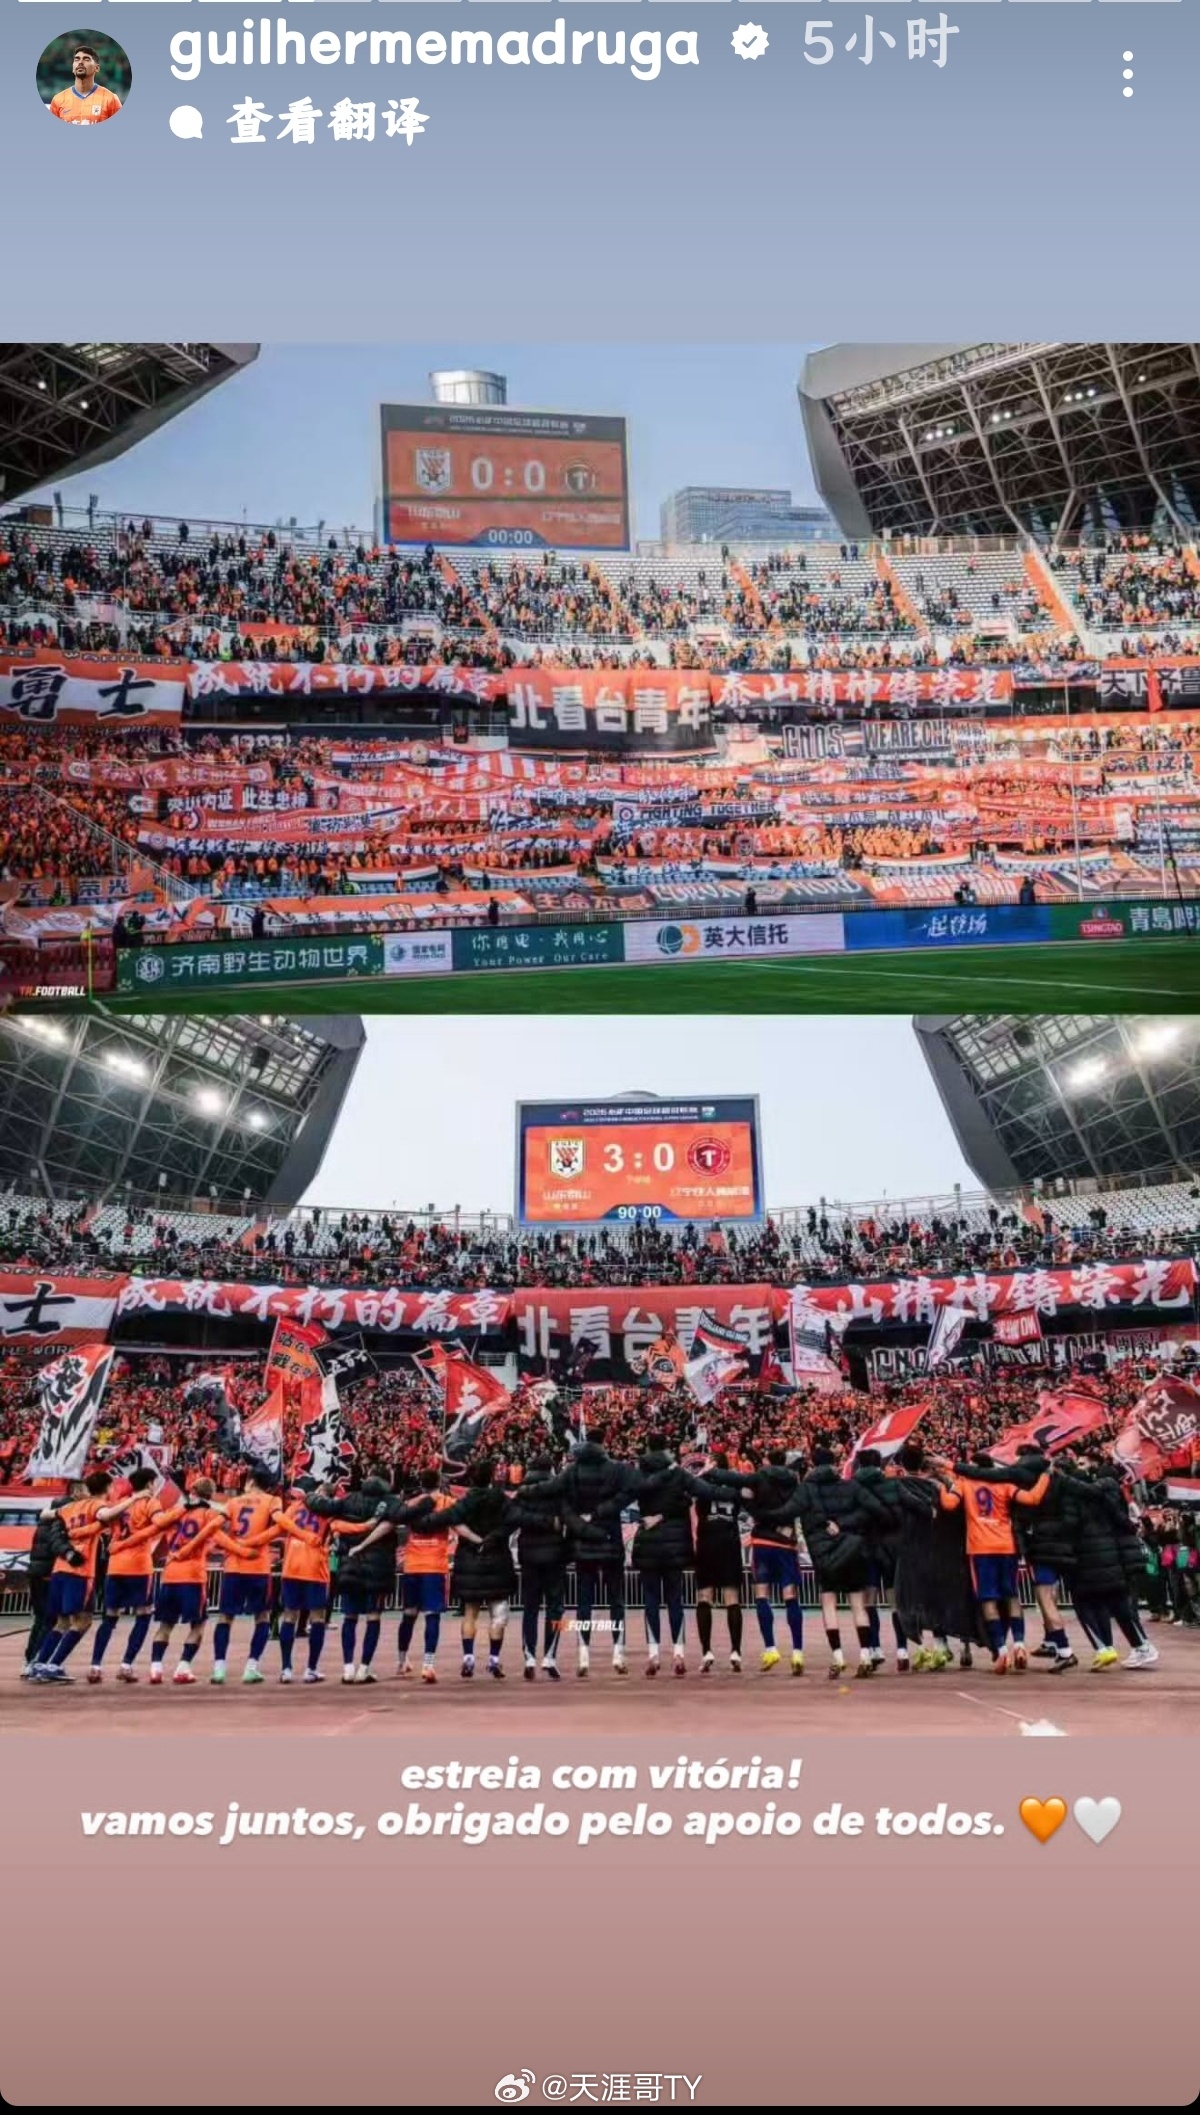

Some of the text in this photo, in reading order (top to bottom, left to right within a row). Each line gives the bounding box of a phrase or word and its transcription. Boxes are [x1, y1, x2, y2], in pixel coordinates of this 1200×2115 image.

[488, 530, 533, 545] 00:00
[187, 660, 505, 704] 成就不朽的篇章
[507, 683, 712, 736] 北看台青年
[639, 803, 702, 821] FIGHTING
[703, 923, 789, 947] 英大信托
[1081, 923, 1123, 934] TSINGTAO
[170, 945, 369, 977] 济南野生动物世界
[508, 954, 545, 965] Power
[116, 1276, 508, 1335] 成就不朽的篇章
[975, 1486, 993, 1516] 9
[233, 1507, 254, 1536] 5
